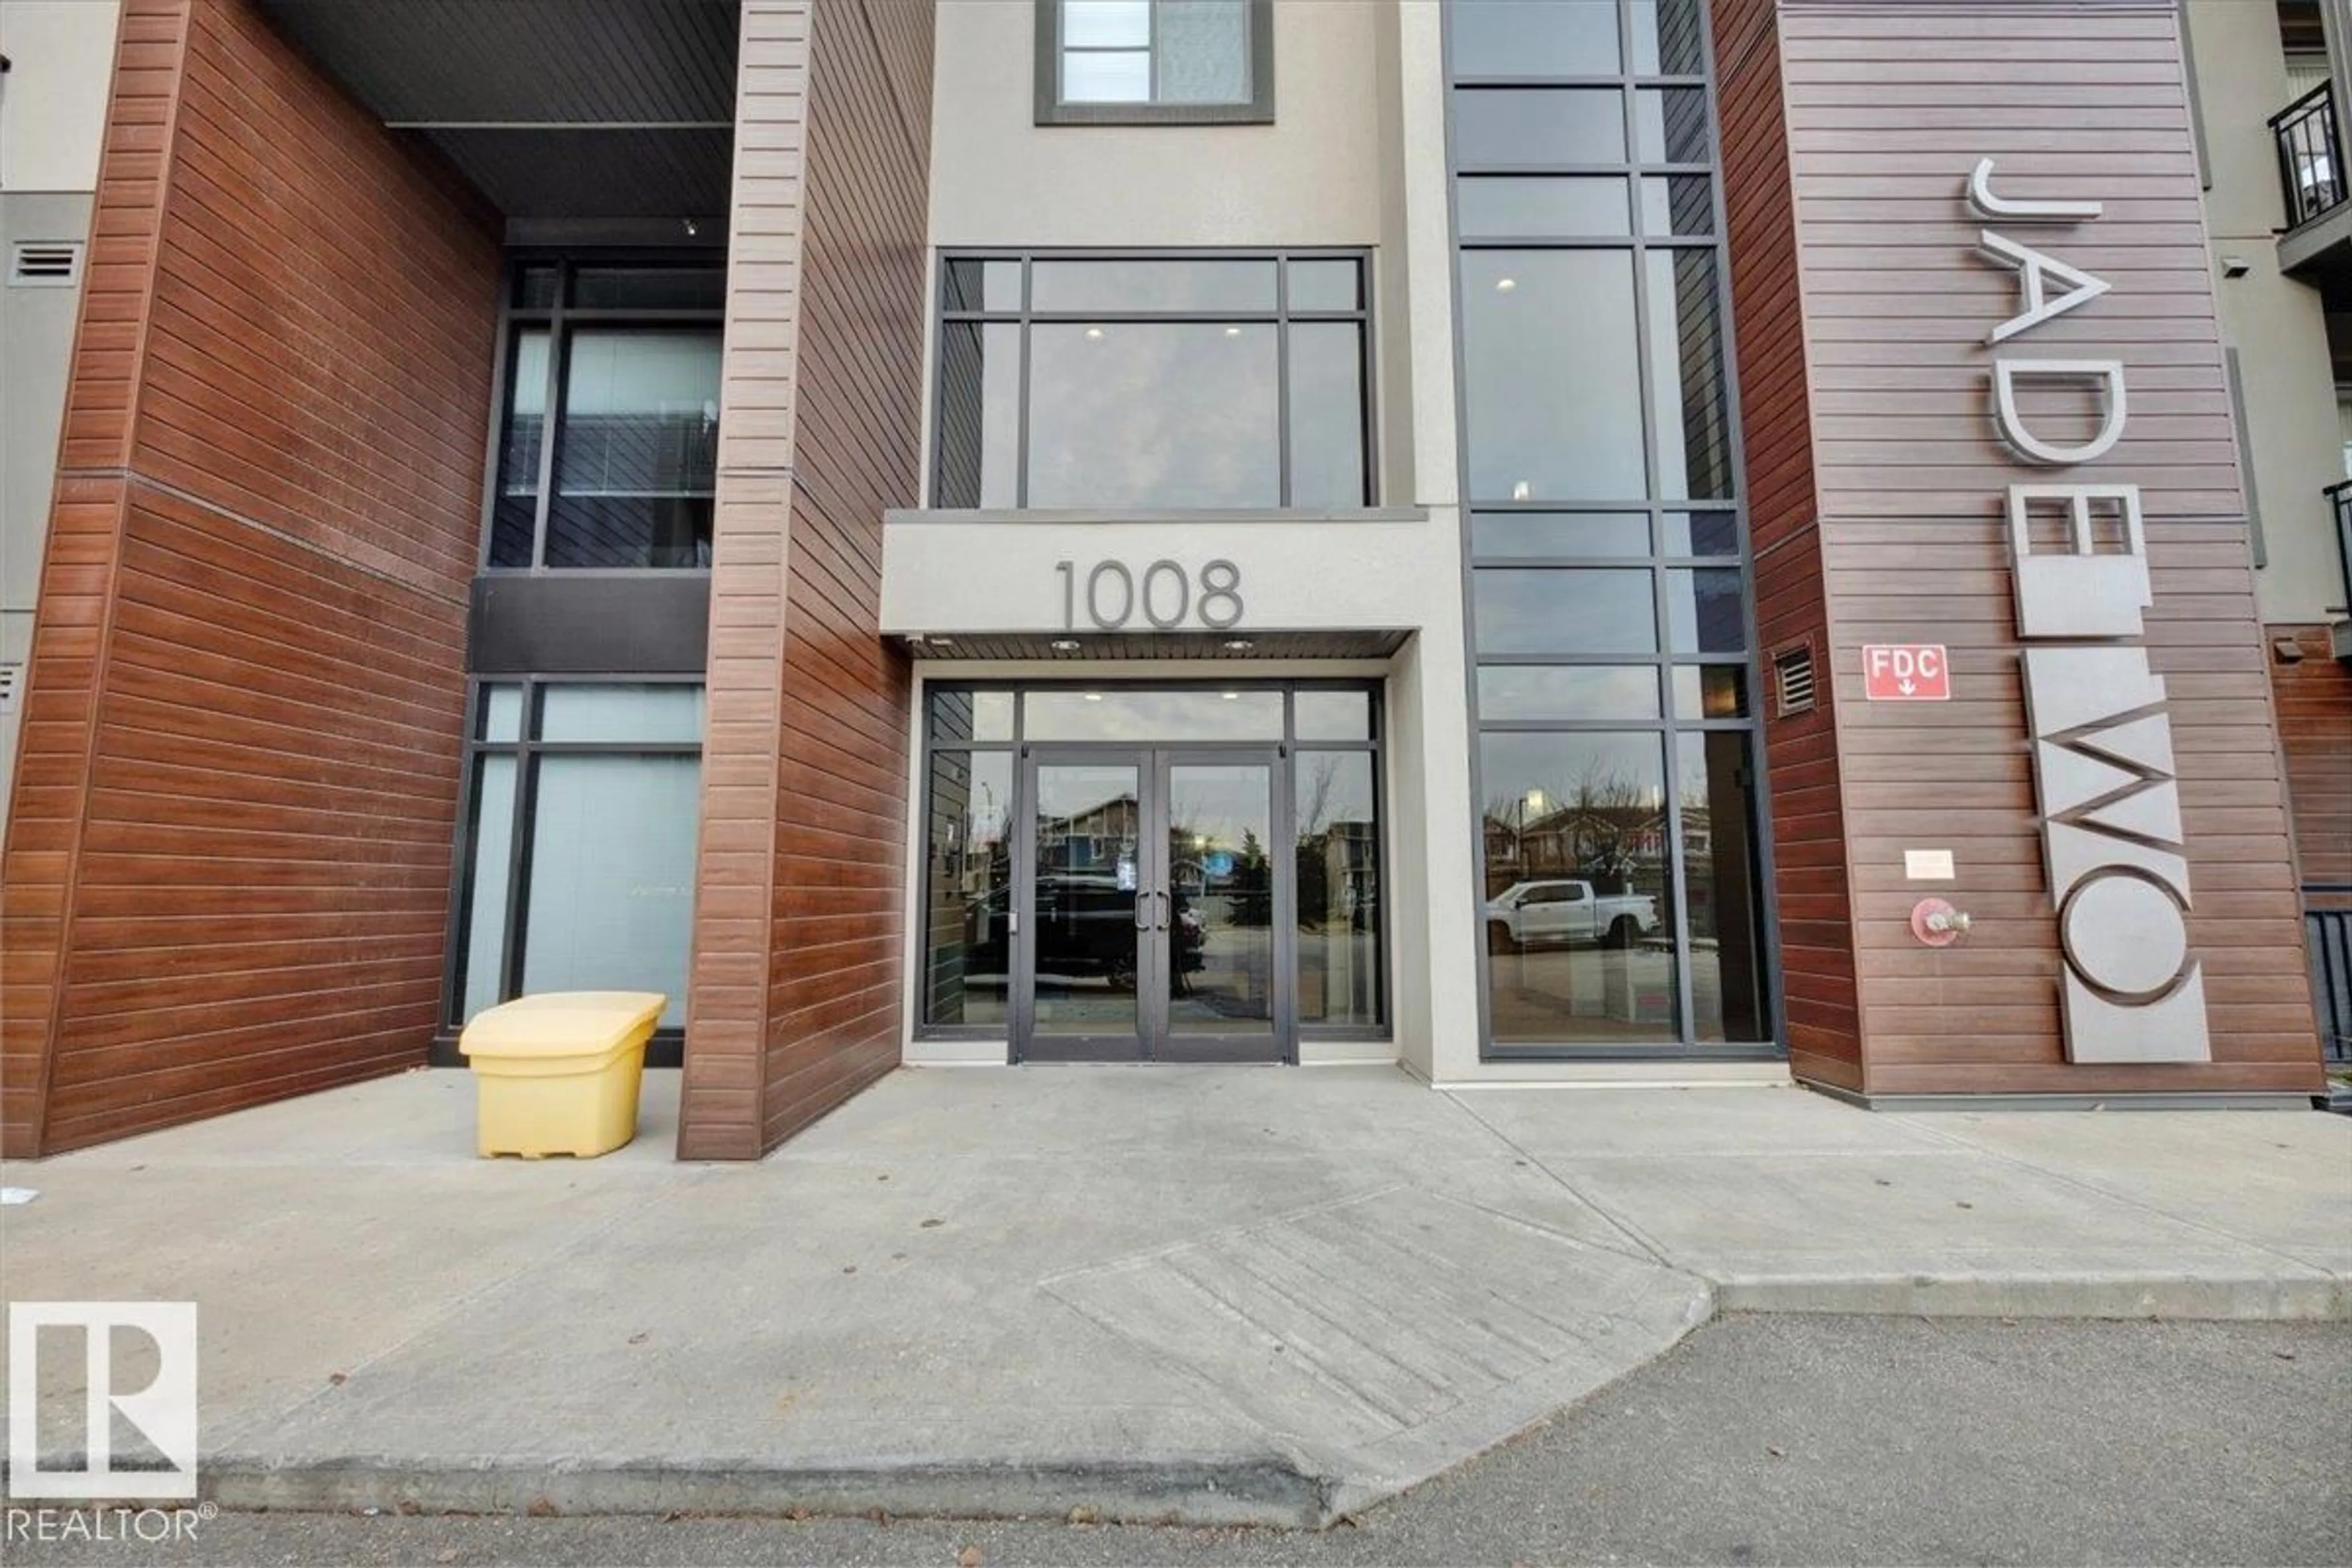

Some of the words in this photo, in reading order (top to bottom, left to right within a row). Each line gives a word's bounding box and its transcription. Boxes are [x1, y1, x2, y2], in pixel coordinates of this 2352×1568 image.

[1966, 157, 2147, 556] JADE
[1055, 559, 1244, 630] 1008
[1872, 649, 1939, 678] FDC
